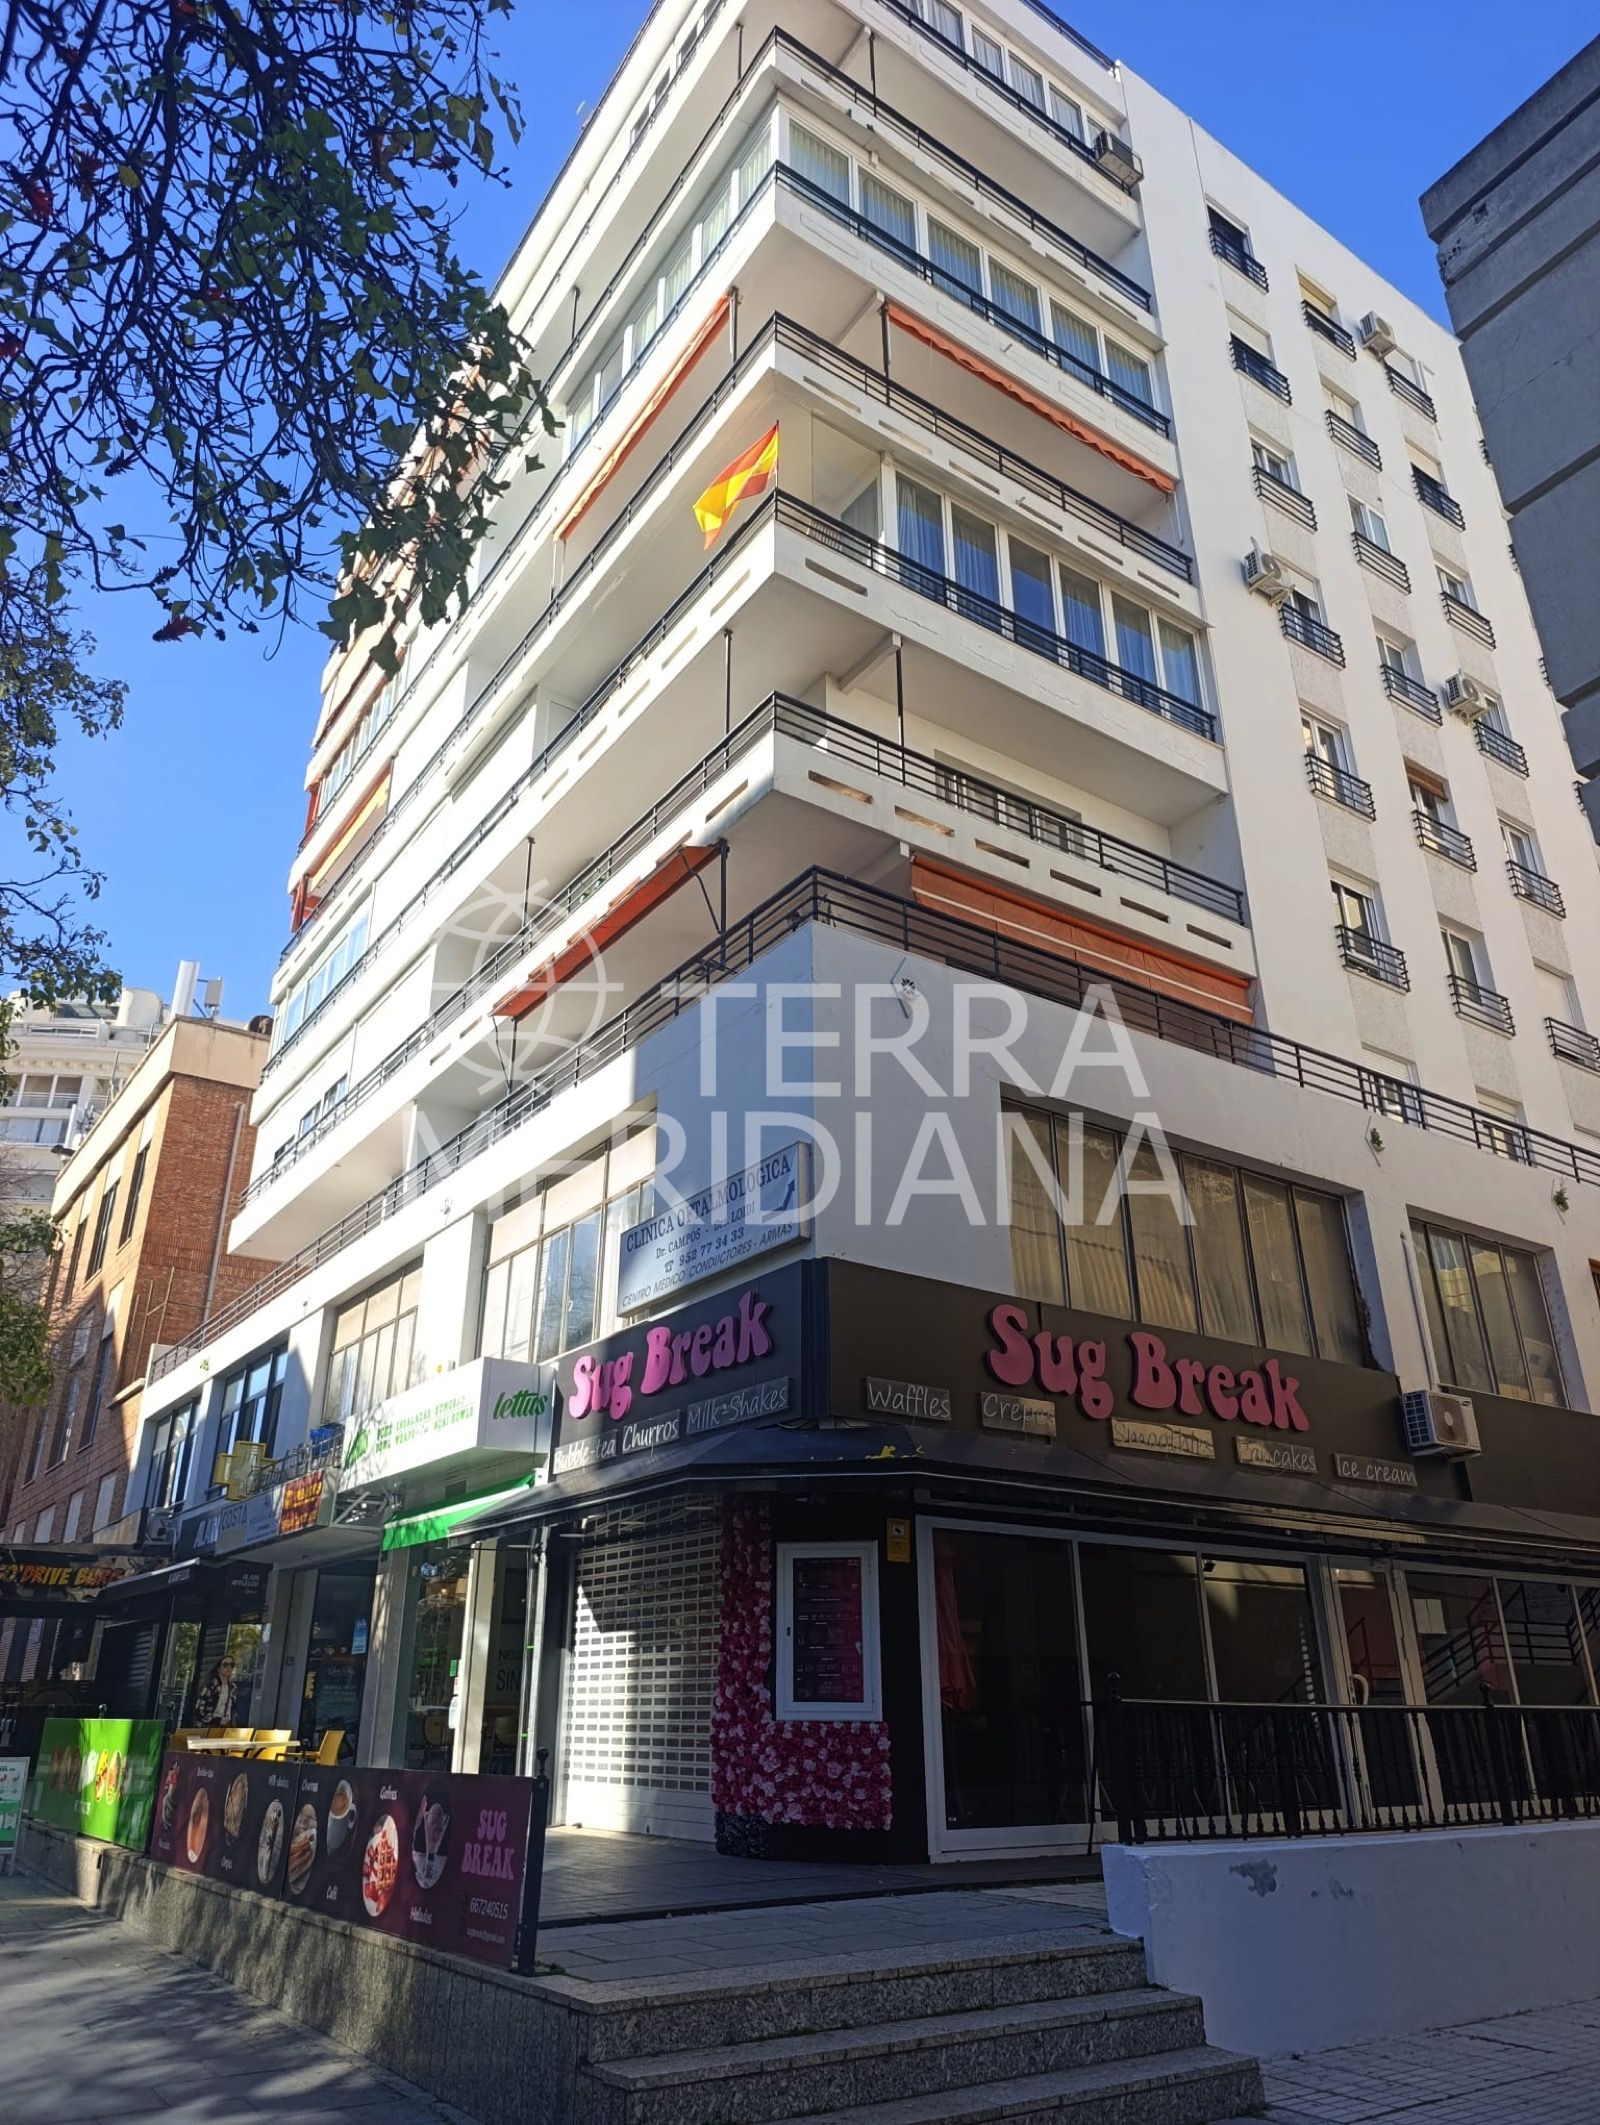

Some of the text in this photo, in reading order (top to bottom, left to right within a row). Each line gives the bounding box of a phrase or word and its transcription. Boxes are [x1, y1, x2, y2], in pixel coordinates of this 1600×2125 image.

[626, 1154, 792, 1253] CLINICA OFTALMOLOGICA
[668, 1228, 701, 1254] CAMPOS
[701, 1244, 713, 1257] 77
[715, 1235, 728, 1250] 34
[731, 1226, 745, 1243] 33
[622, 1284, 651, 1307] CENTRO
[653, 1270, 686, 1293] MEDICO
[688, 1237, 753, 1279] CONDUCTORES
[758, 1221, 793, 1247] ARMAS
[568, 1290, 773, 1420] Sug Break
[989, 1303, 1310, 1431] Sug Break
[868, 1382, 951, 1418] Waffles
[622, 1417, 680, 1452] Churros
[1340, 1454, 1417, 1483] Ice cream
[221, 1503, 247, 1531] COSTA
[477, 1809, 507, 1842] SUG
[461, 1842, 515, 1881] BREAK
